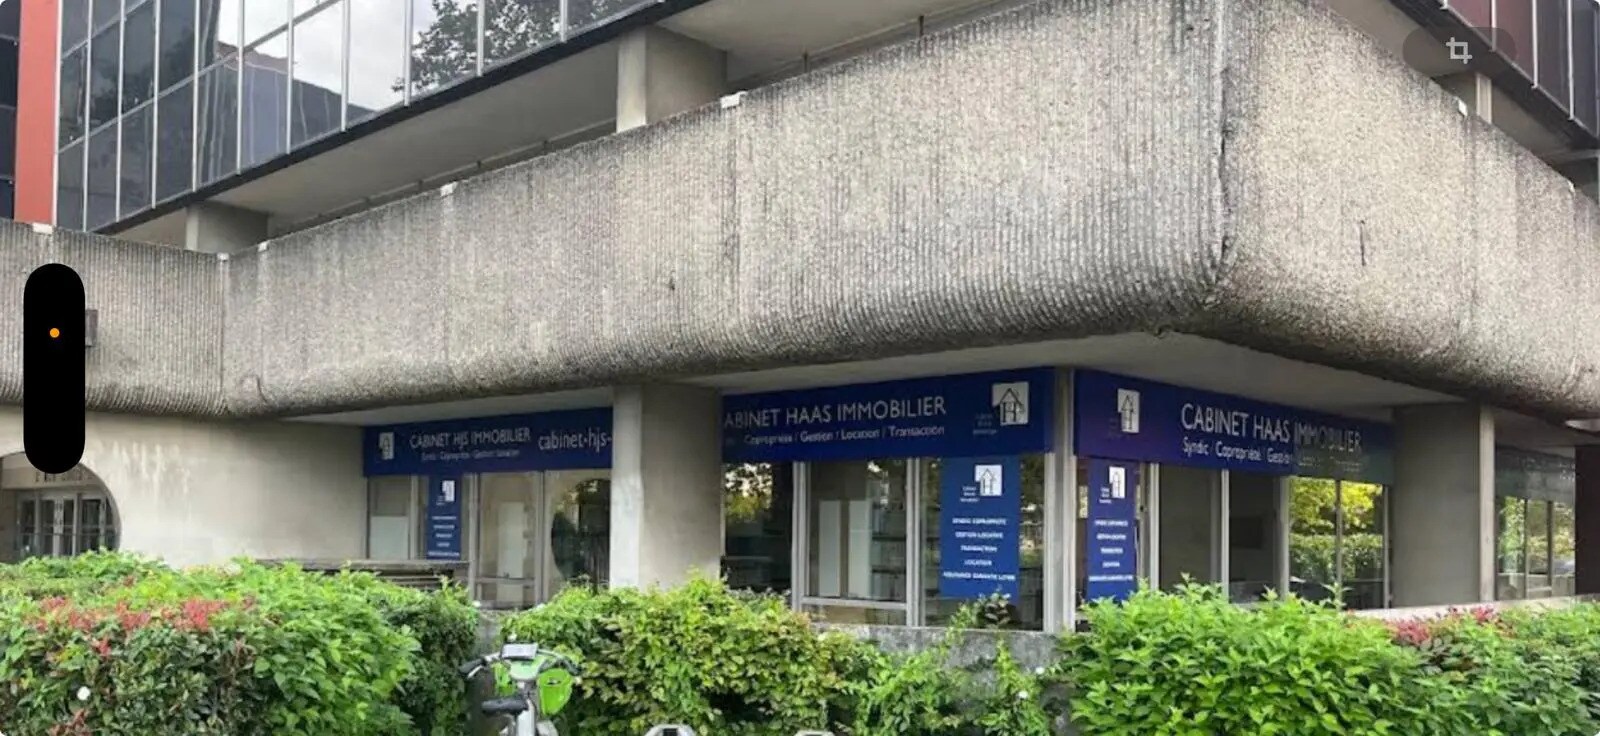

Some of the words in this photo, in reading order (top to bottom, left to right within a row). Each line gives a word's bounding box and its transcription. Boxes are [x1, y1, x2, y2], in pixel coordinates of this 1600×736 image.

[724, 409, 780, 428] ABINET
[786, 405, 831, 424] HAAS
[837, 396, 947, 421] IMMOBILIER
[1181, 403, 1249, 437] CABINET
[1253, 415, 1290, 443] HAAS
[409, 433, 449, 449] CABINET
[471, 427, 530, 445] IMMOBILIER
[841, 429, 879, 441] Location
[888, 425, 944, 438] Transaction
[1182, 436, 1208, 457] Syndic
